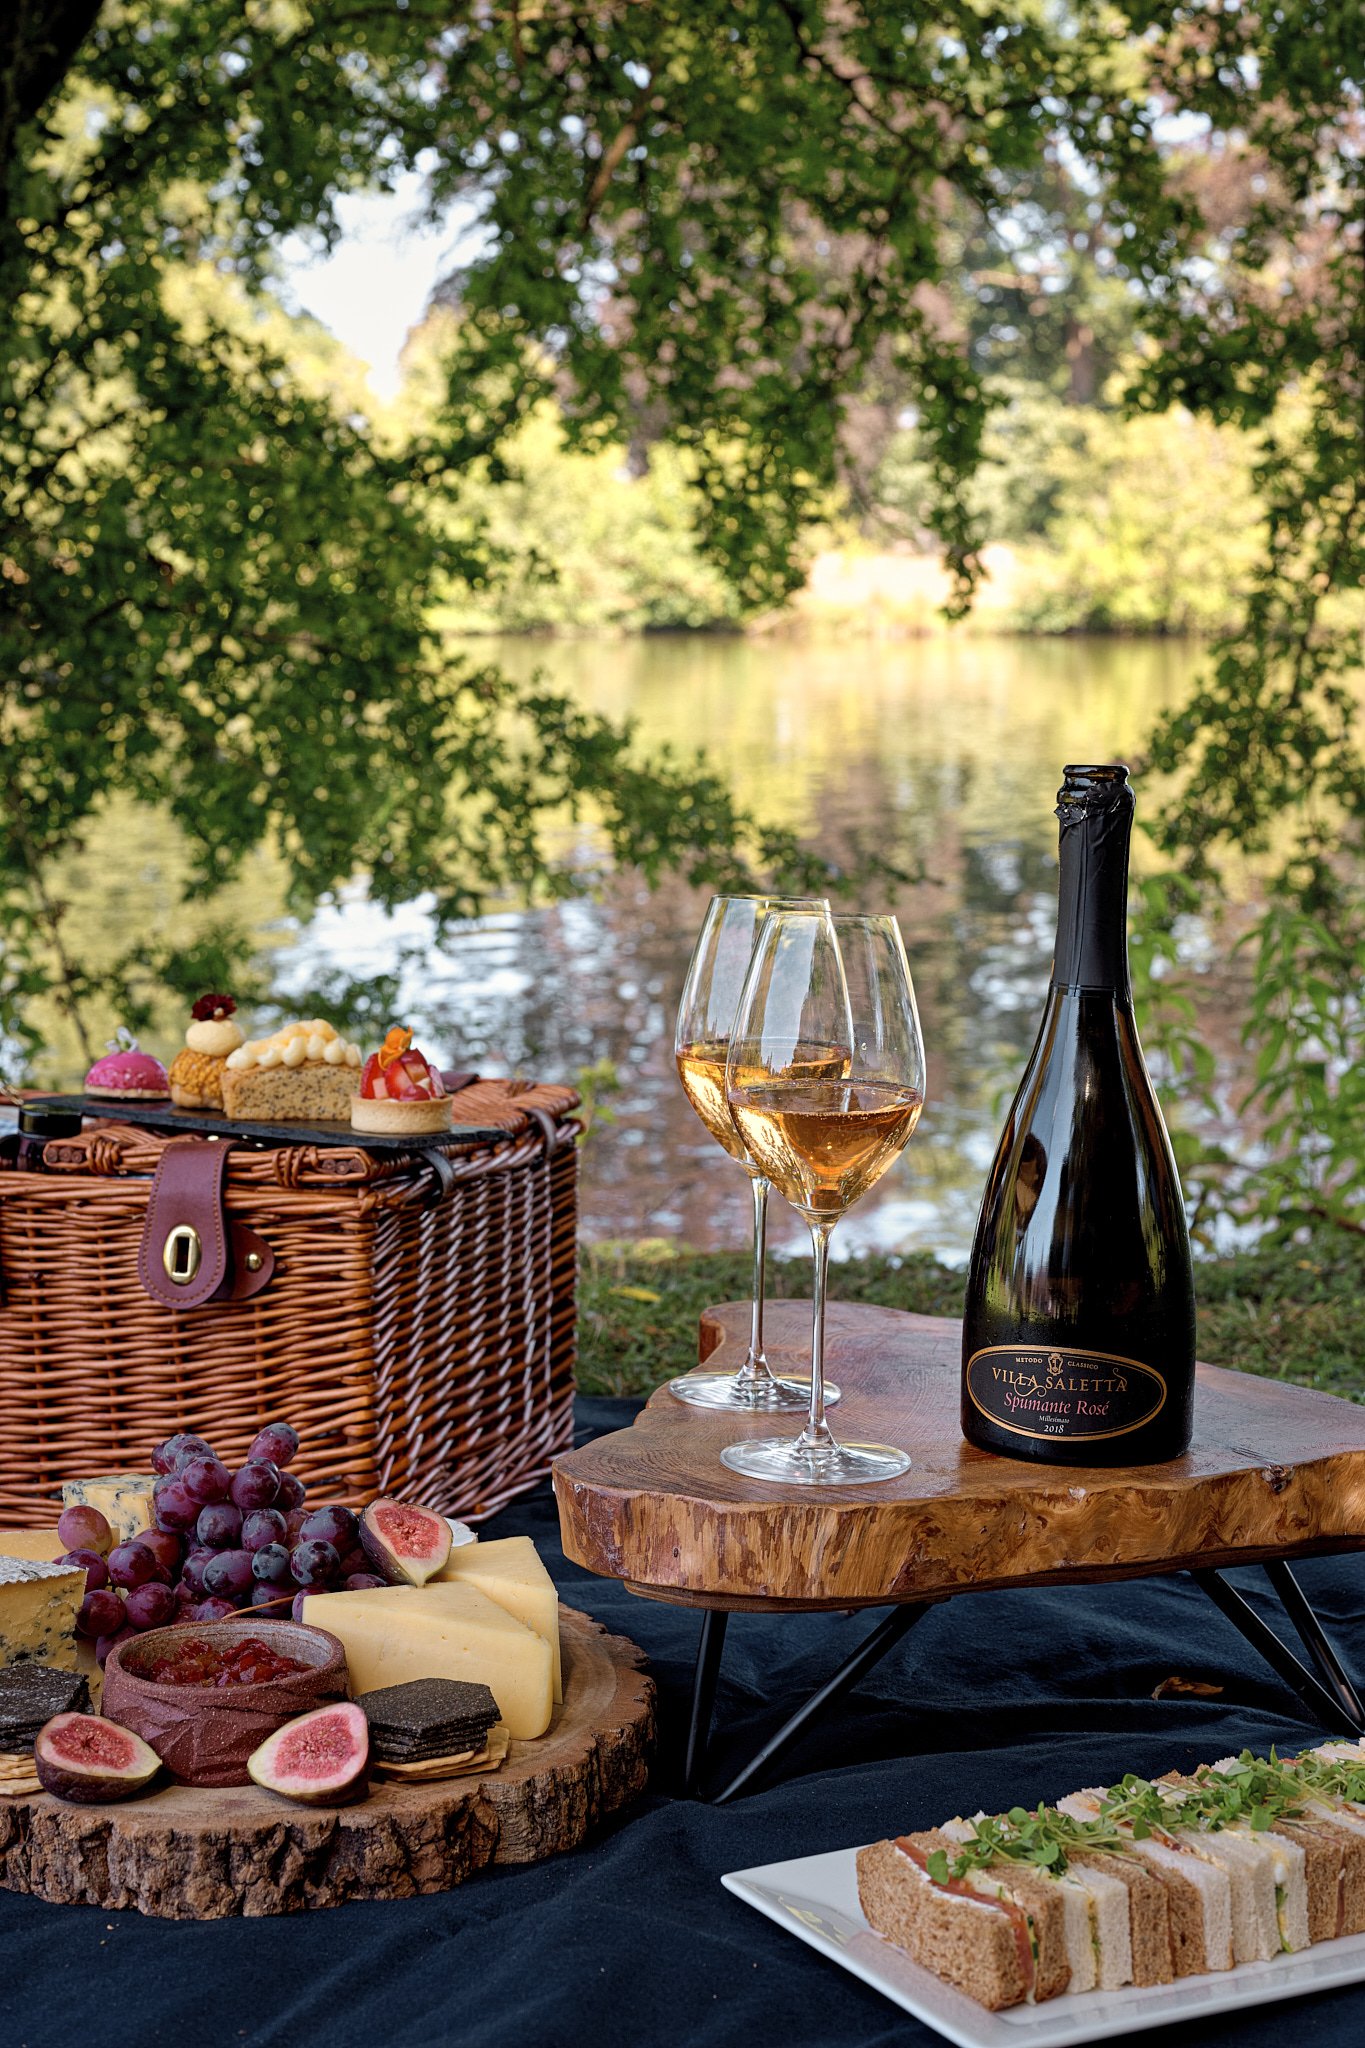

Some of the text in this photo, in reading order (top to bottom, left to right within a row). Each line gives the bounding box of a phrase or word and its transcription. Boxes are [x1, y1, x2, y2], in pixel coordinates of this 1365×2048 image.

[1067, 1360, 1099, 1370] CLASSICO
[991, 1367, 1128, 1392] VILLA SALETTA
[1003, 1392, 1110, 1416] Spumante Rosé
[1043, 1424, 1065, 1434] 2018
